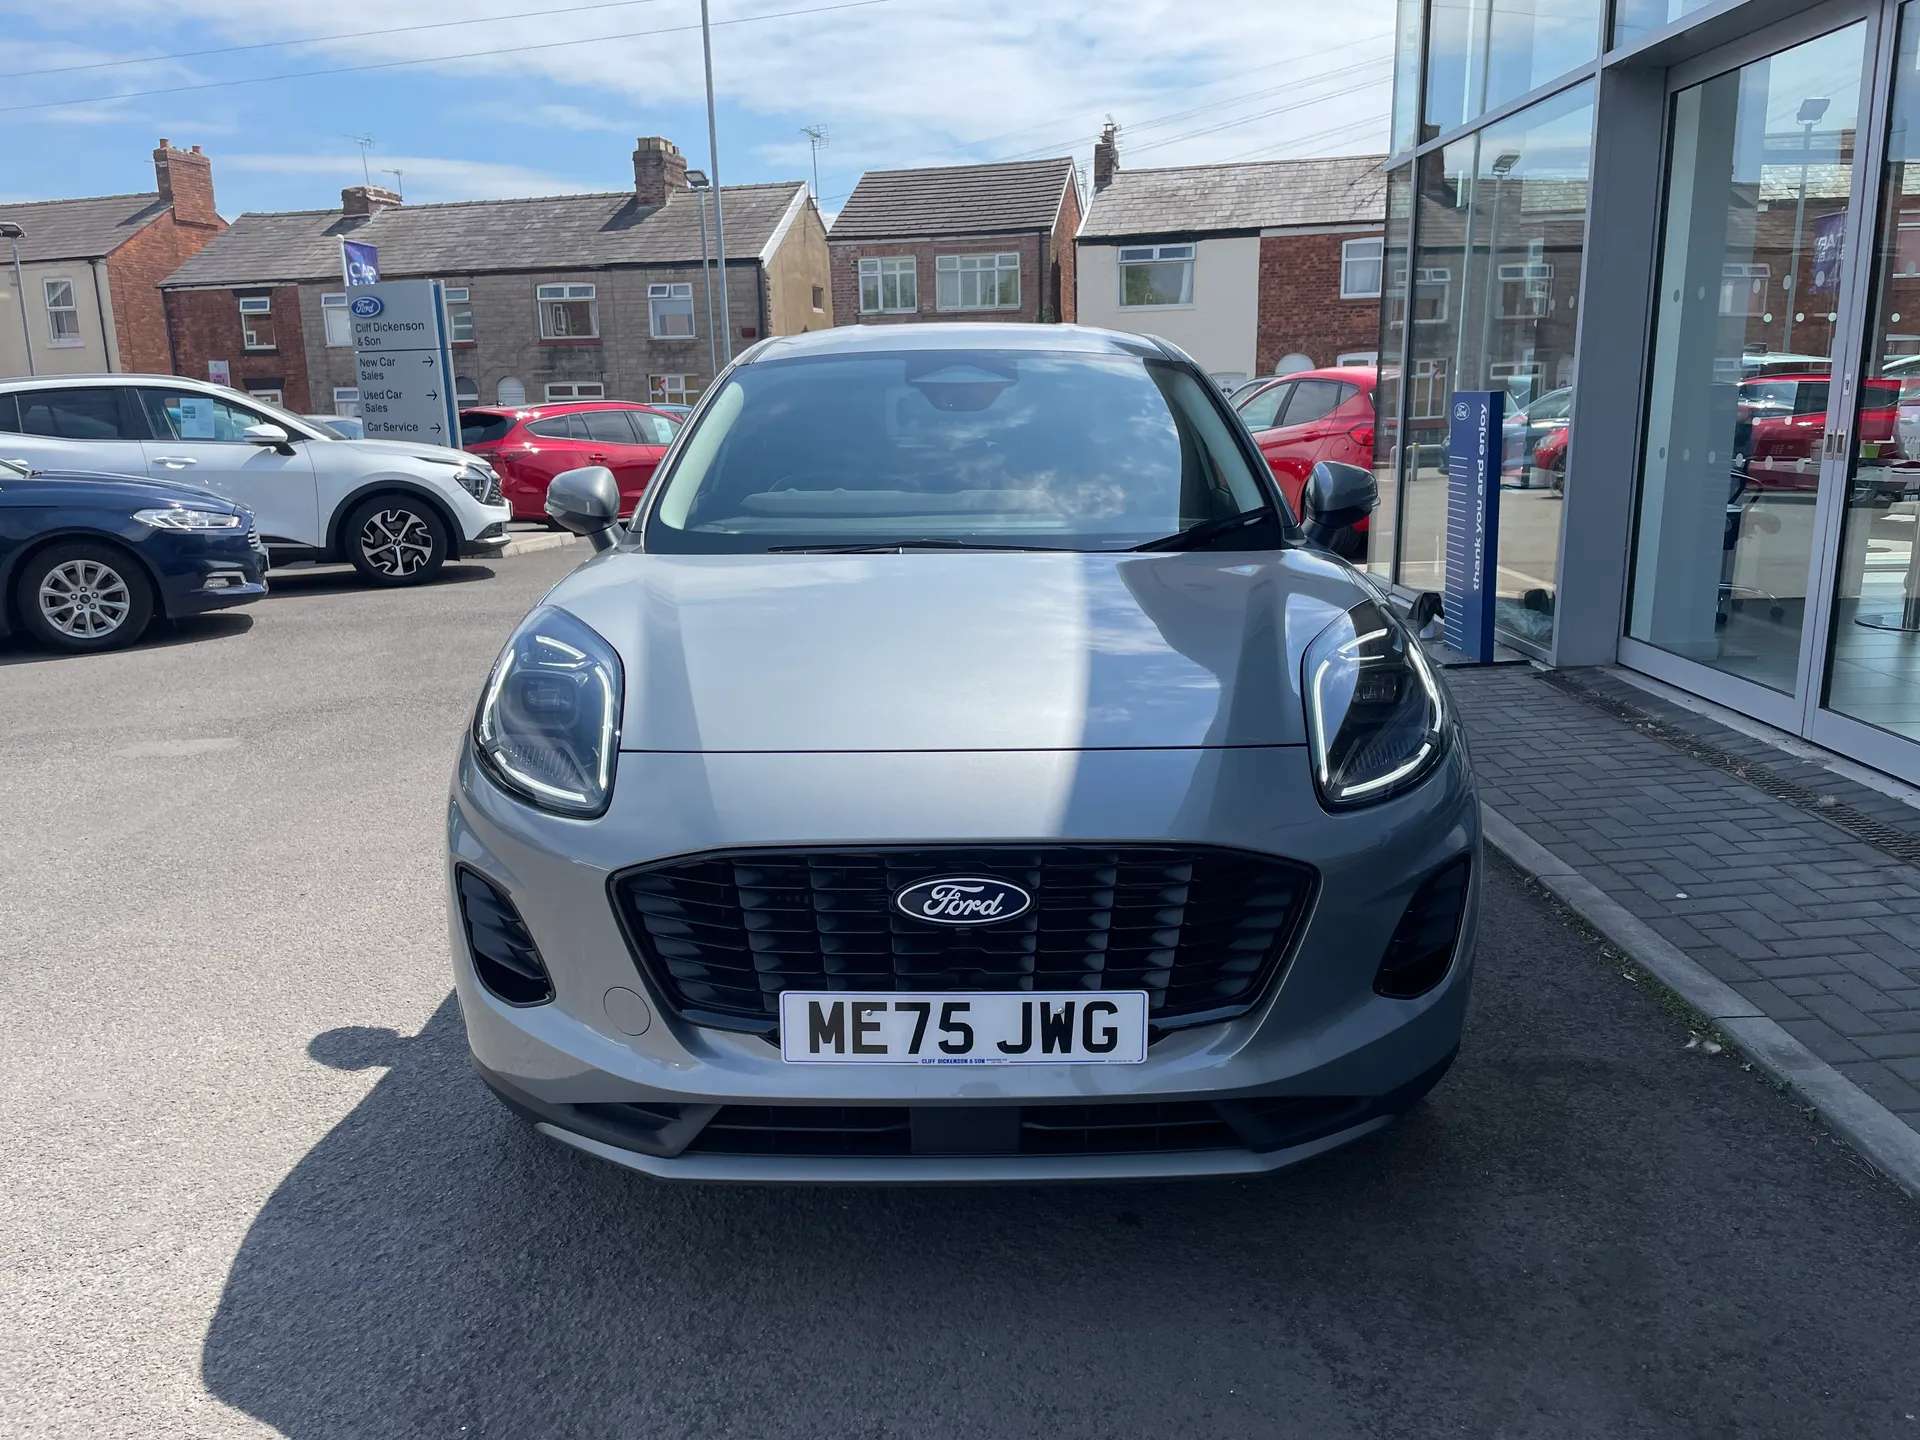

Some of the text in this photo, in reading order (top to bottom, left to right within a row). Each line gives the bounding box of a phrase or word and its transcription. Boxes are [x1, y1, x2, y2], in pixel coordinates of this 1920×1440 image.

[355, 301, 375, 313] Ford
[355, 321, 425, 333] Cliff Dickenson
[357, 336, 381, 346] & Son
[359, 357, 396, 368] New Car
[361, 371, 384, 381] Sales
[363, 389, 403, 400] Used Car
[365, 403, 388, 413] Sales
[367, 422, 419, 432] Car Service
[1473, 403, 1487, 591] thank you and enjoy
[923, 884, 1004, 916] Ford
[808, 1001, 1118, 1055] ME75 JWG
